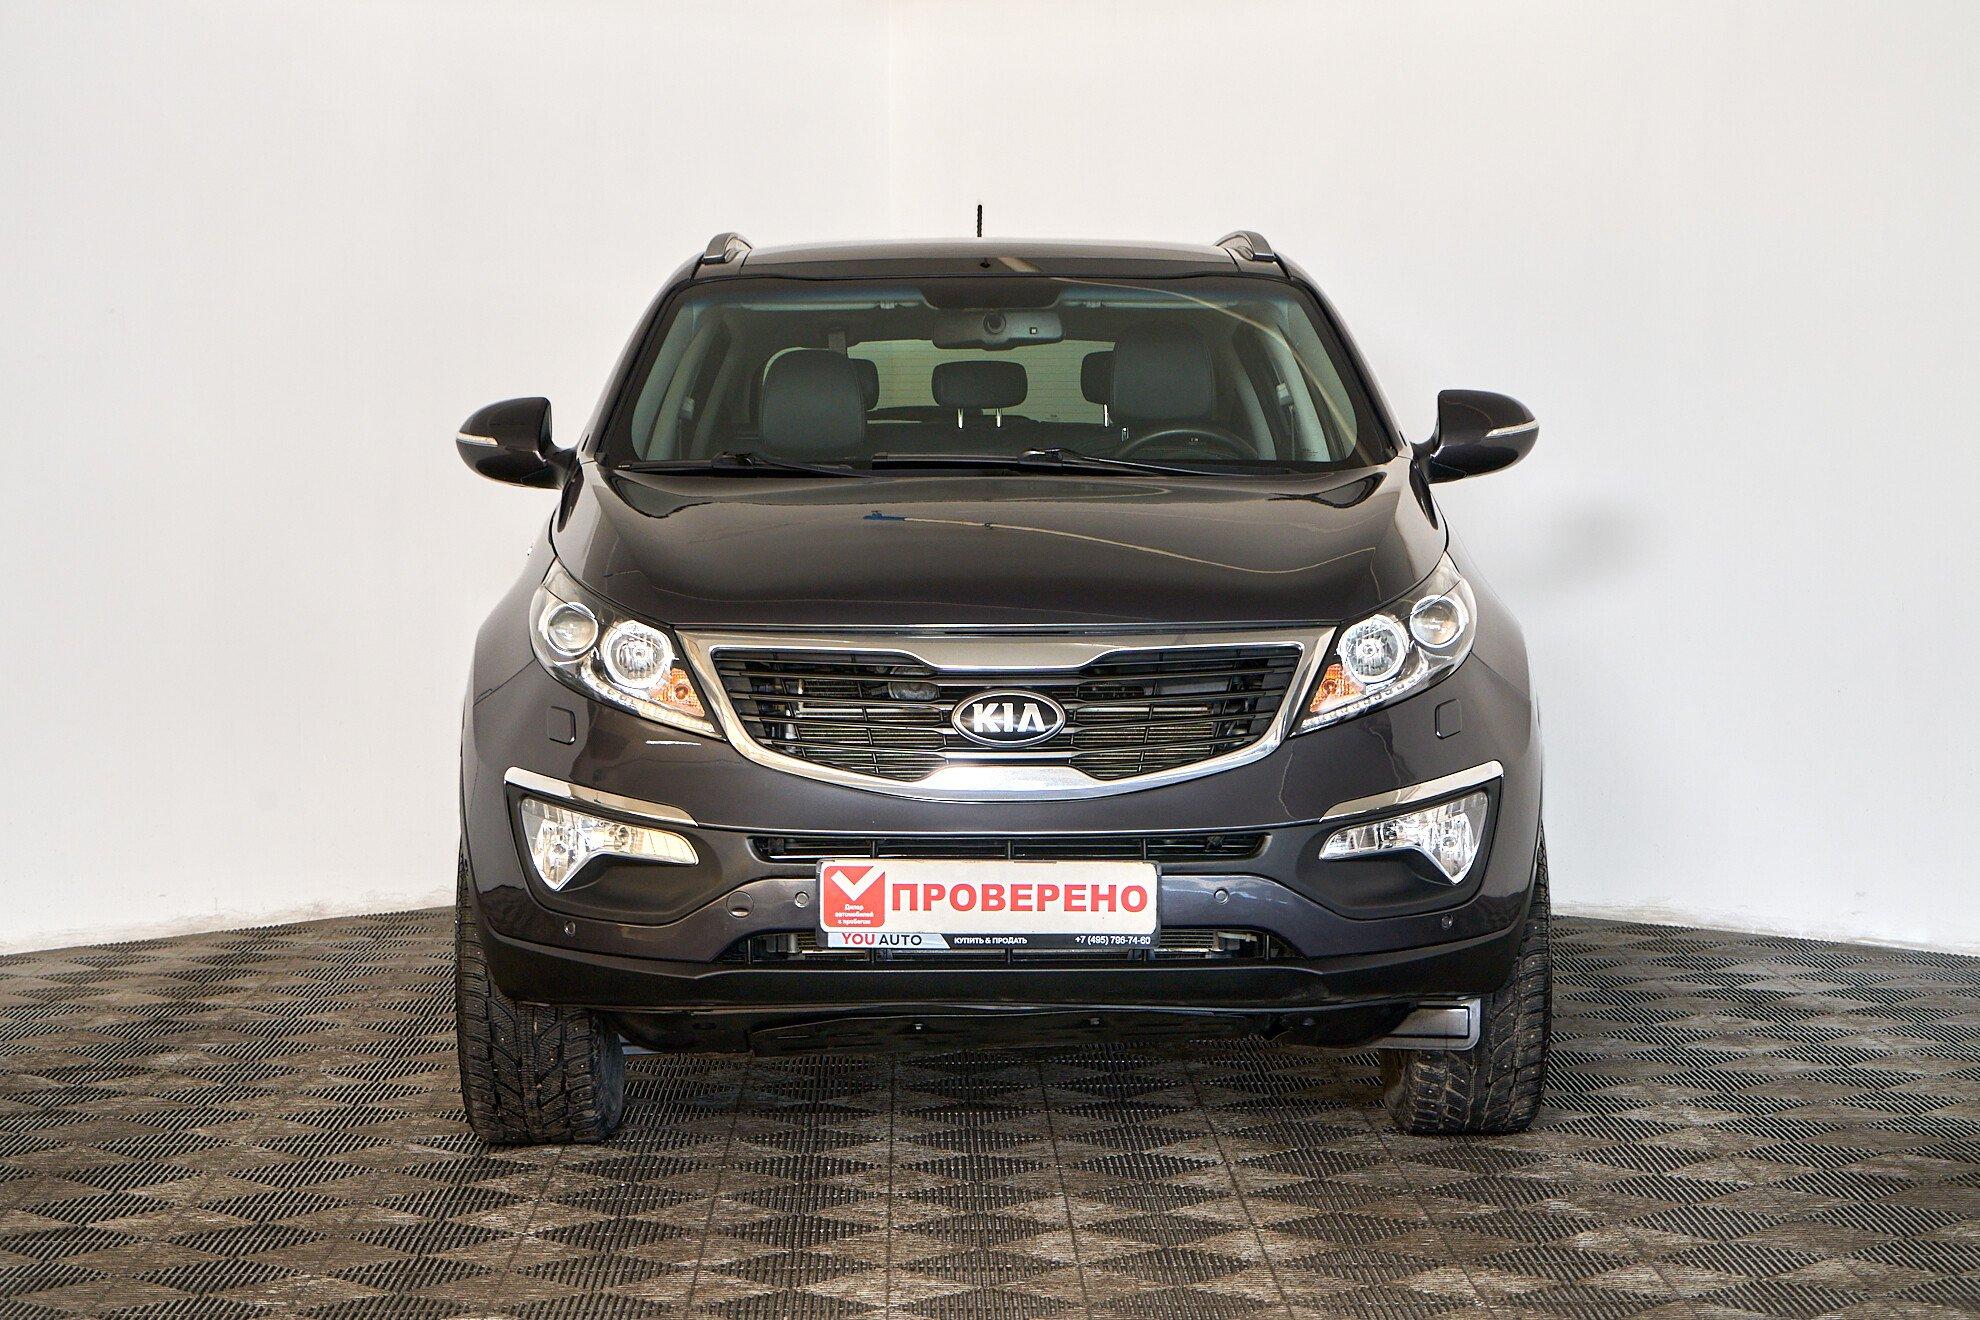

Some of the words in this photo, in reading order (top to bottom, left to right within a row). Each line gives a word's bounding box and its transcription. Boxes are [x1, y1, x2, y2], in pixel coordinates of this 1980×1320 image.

[972, 702, 1046, 733] KIA
[892, 884, 1148, 912] ПРОВЕРЕНО
[841, 932, 875, 945] YOU
[878, 933, 922, 946] AUTO
[953, 937, 984, 945] КУПИТЬ
[984, 937, 992, 945] &
[992, 937, 1028, 945] ПРОДАТЬ
[1074, 935, 1086, 944] +7
[1087, 935, 1109, 946] (495)
